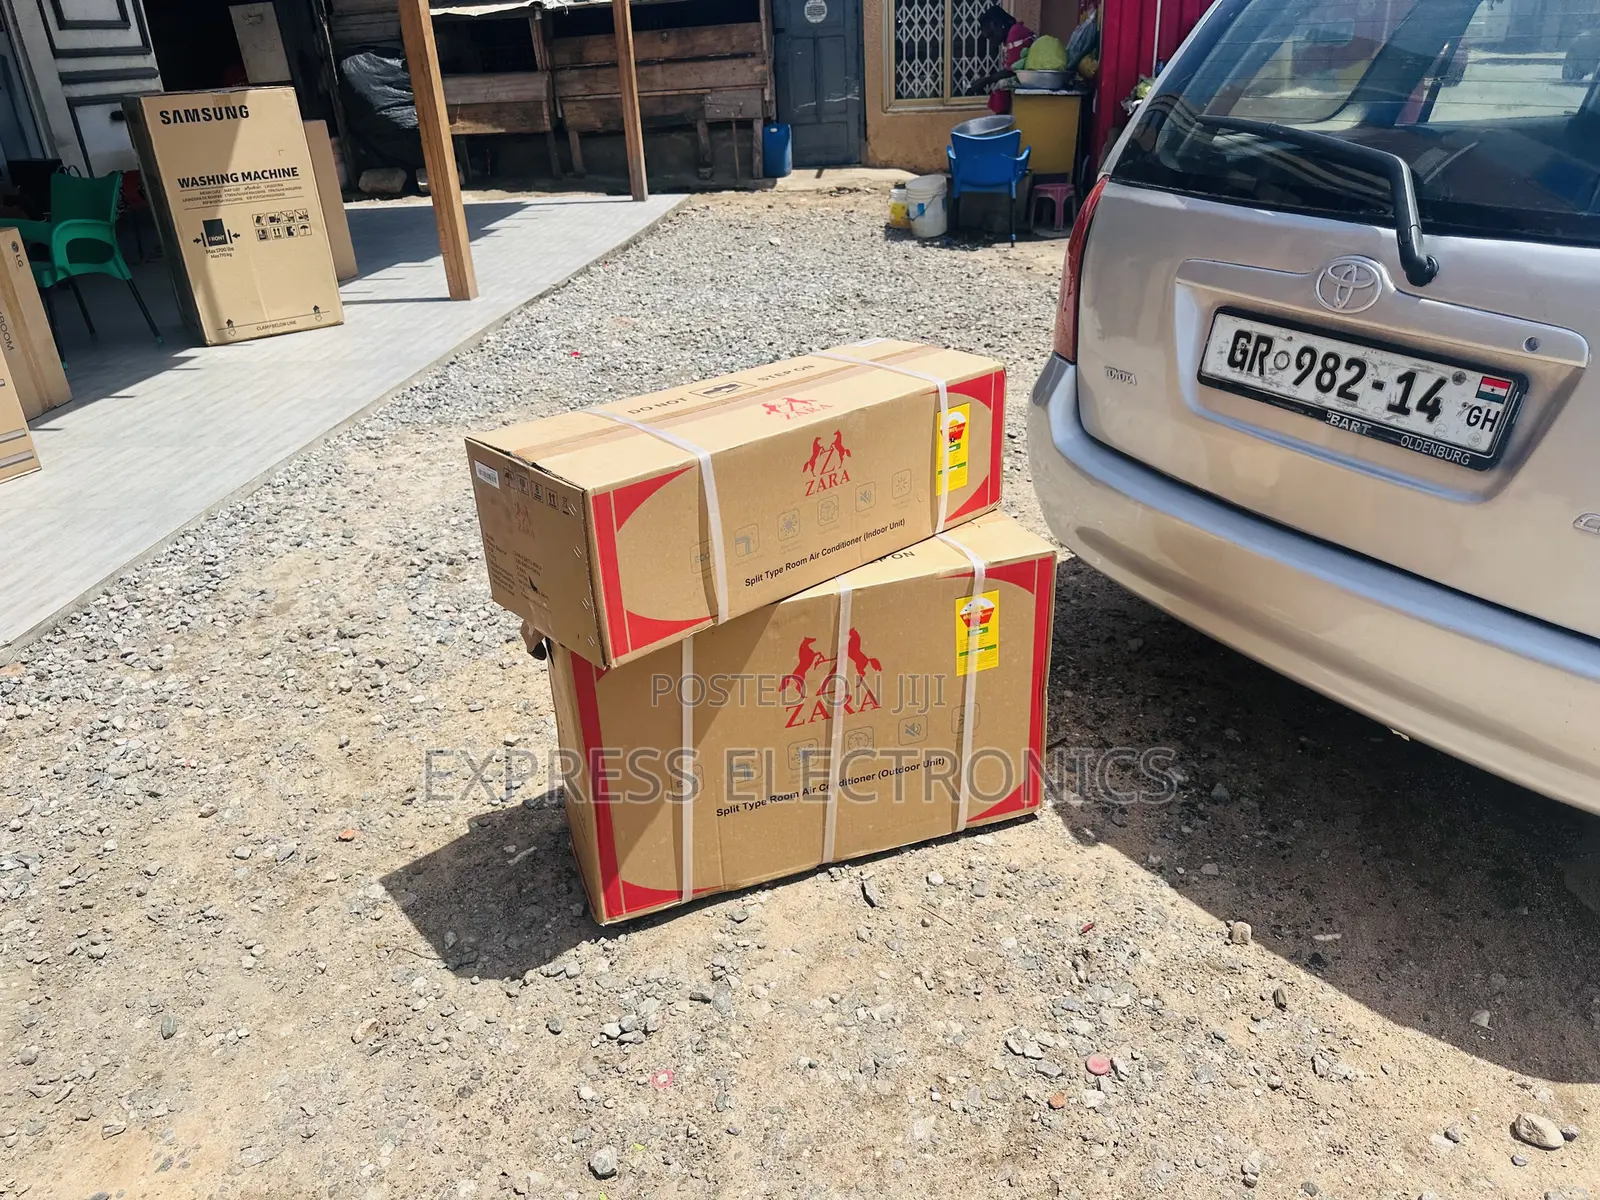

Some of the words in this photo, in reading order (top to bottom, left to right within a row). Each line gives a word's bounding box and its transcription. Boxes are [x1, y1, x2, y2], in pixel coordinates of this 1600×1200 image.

[159, 105, 250, 125] SAMSUNG
[177, 172, 239, 188] WASHING
[241, 167, 299, 183] MACHINE
[208, 234, 226, 242] FRONT
[15, 254, 24, 268] LG
[628, 405, 653, 415] DO
[656, 397, 688, 410] NOT
[757, 370, 793, 382] STEP
[794, 363, 816, 373] ON
[1104, 365, 1137, 386] TOYOTA
[1227, 328, 1275, 377] GR
[1295, 346, 1448, 424] 982-14
[1466, 405, 1500, 432] GH
[1400, 435, 1471, 465] OLDENBURG
[805, 469, 851, 497] ZARA
[745, 574, 763, 587] Split
[765, 566, 784, 579] Type
[785, 557, 808, 571] Room
[809, 551, 820, 562] Air
[821, 535, 862, 557] Conditioner
[863, 525, 888, 542] (Indoor
[889, 518, 905, 530] Unit)
[891, 551, 915, 560] ON
[716, 804, 740, 817] Split
[742, 799, 767, 813] Type
[769, 791, 799, 804] Room
[802, 785, 817, 797] Air
[818, 771, 876, 792] Coditioner
[877, 761, 921, 781] (Outdoor
[922, 756, 945, 769] Unit)
